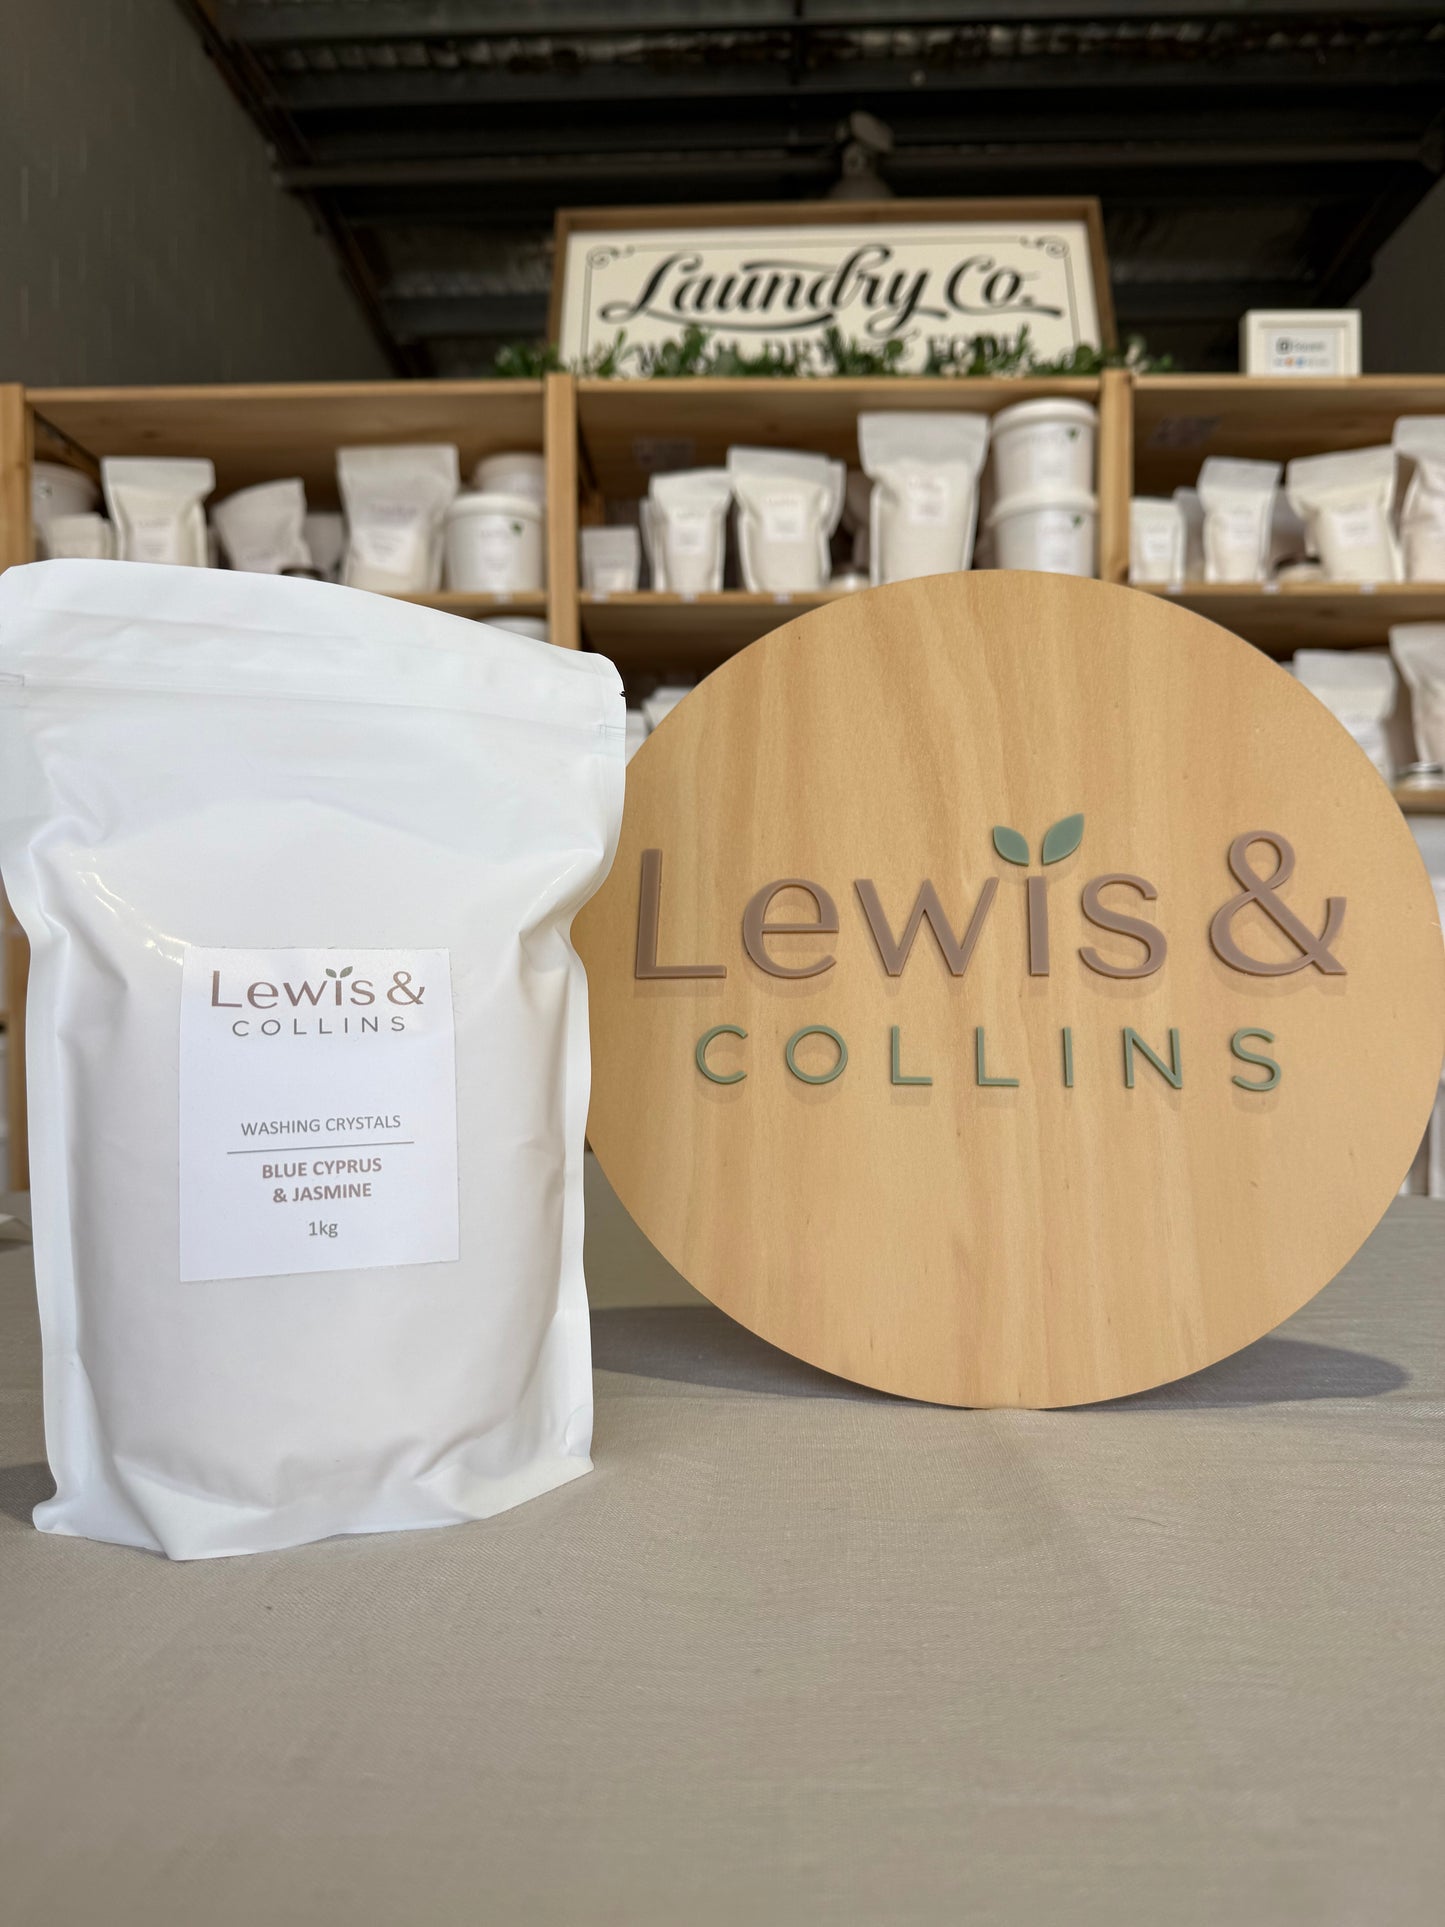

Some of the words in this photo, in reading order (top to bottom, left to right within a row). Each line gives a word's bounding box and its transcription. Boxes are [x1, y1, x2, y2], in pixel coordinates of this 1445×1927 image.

[600, 243, 950, 337] Laundry
[944, 254, 1064, 317] Co.
[634, 812, 1168, 980] Lewis
[1207, 829, 1348, 977] &
[210, 965, 377, 1009] Lewis
[386, 970, 426, 1006] &
[231, 1015, 406, 1037] COLLINS
[695, 1023, 1283, 1092] COLLINS
[240, 1119, 321, 1137] WASHING
[325, 1114, 402, 1131] CRYSTALS
[261, 1162, 308, 1179] BLUE
[312, 1157, 383, 1175] CYPRUS
[272, 1187, 288, 1203] &
[292, 1182, 373, 1202] JASMINE
[307, 1220, 339, 1238] 1kg
